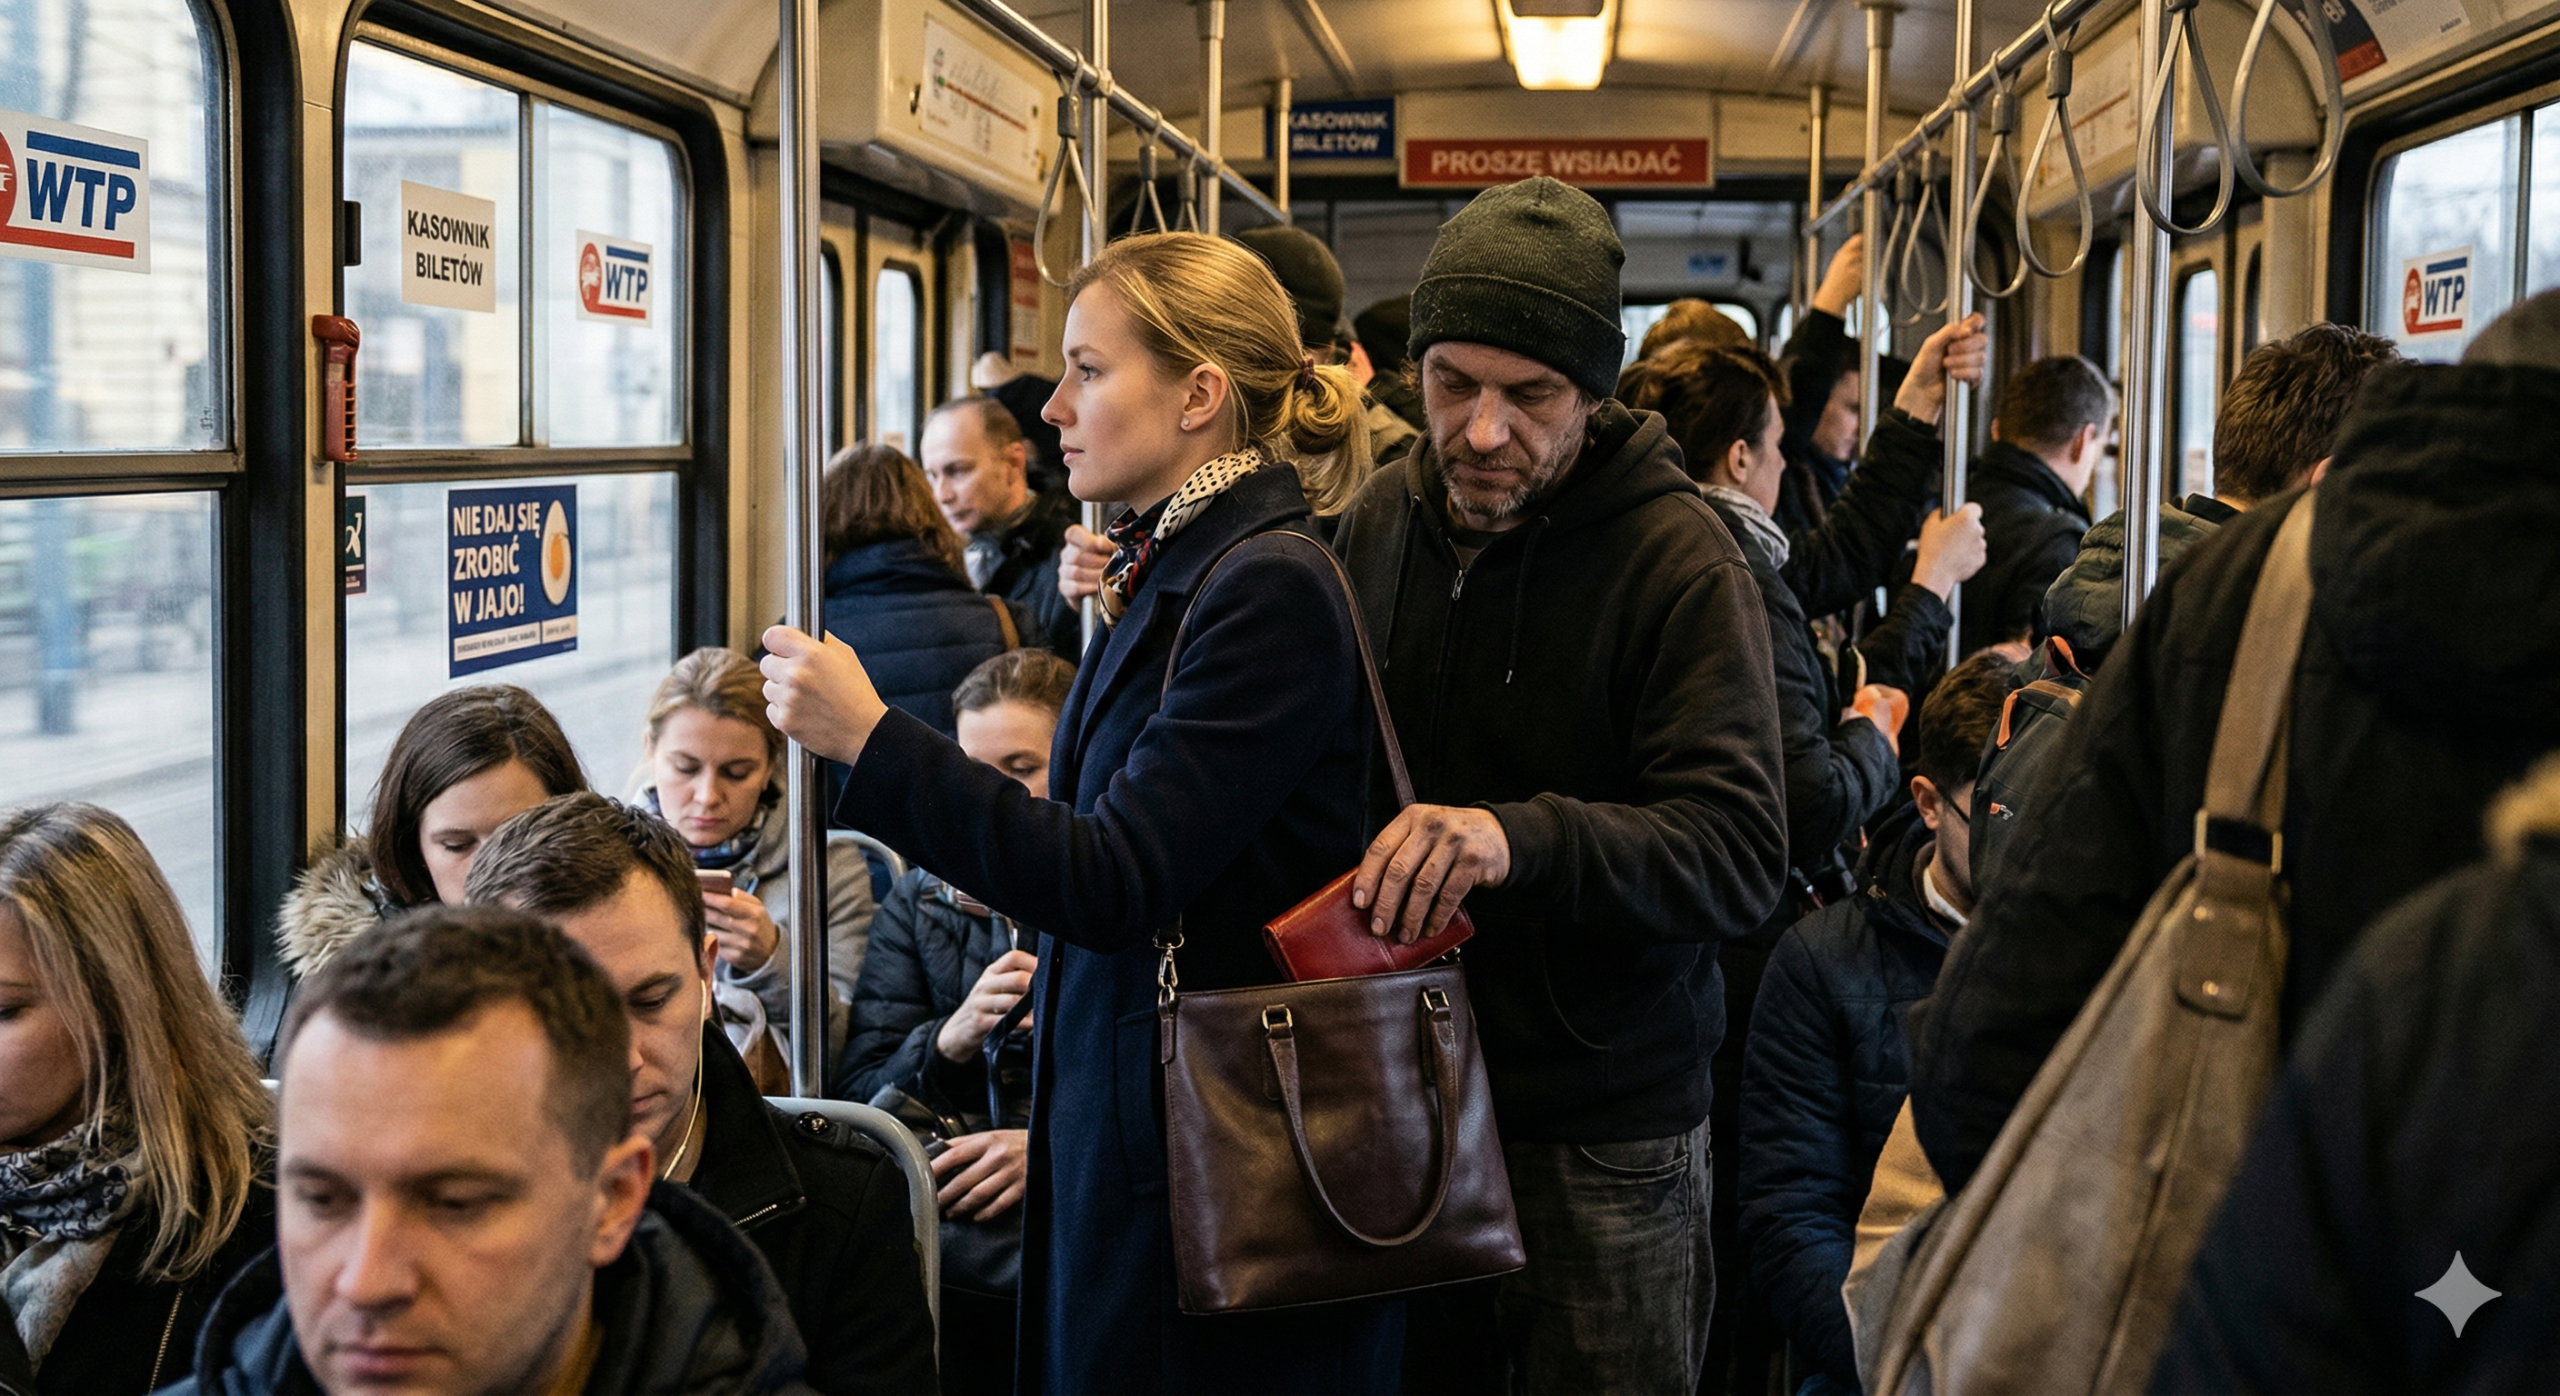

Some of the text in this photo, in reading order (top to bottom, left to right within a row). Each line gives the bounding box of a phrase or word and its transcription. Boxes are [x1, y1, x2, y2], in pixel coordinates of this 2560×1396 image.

[1292, 130, 1380, 152] BILETÓW
[1549, 143, 1683, 175] WSIADAĆ
[26, 158, 137, 231] WTP
[407, 209, 490, 249] KASOWNIK
[416, 252, 483, 286] BILETÓW
[605, 262, 648, 303] WTP
[2425, 275, 2465, 316] WTP
[453, 501, 541, 539] NIE DAJ SIĘ
[453, 534, 520, 581] ZROBIĆ
[453, 583, 525, 625] W JAJO!
